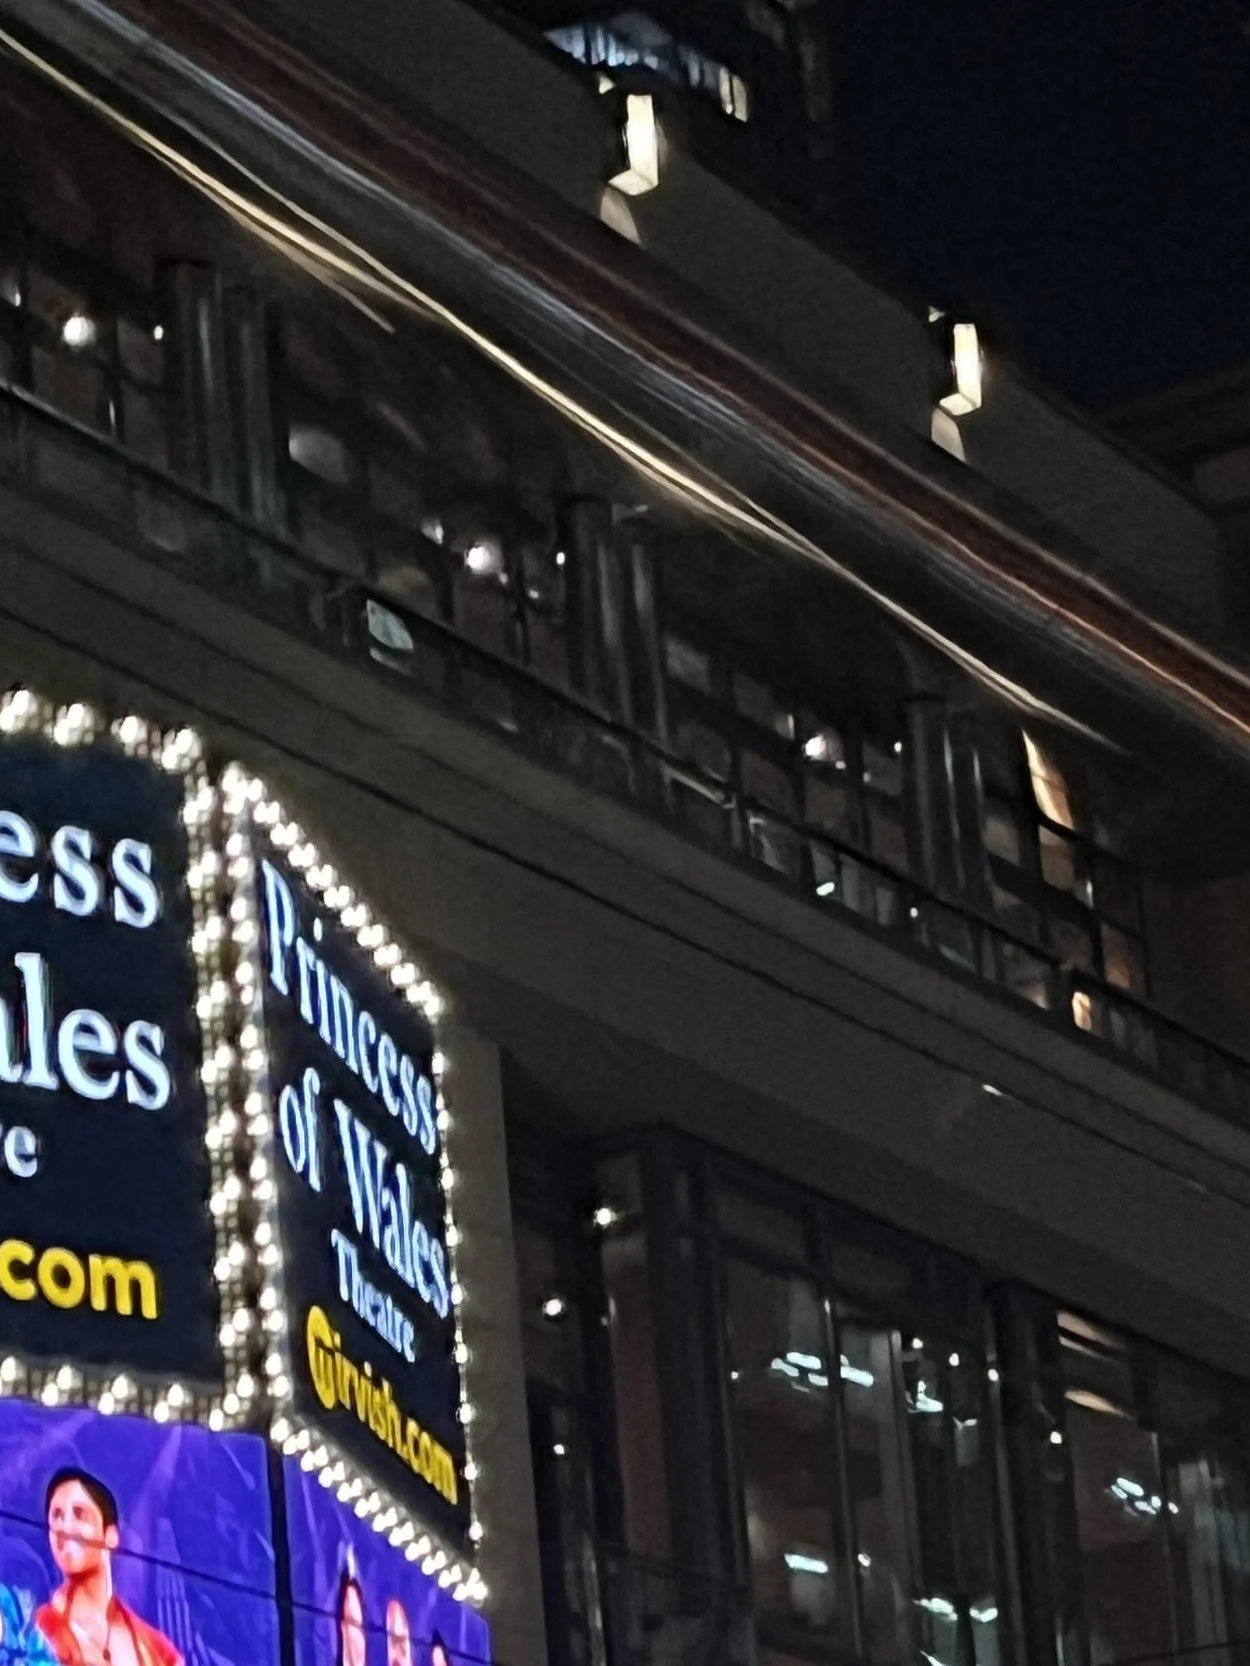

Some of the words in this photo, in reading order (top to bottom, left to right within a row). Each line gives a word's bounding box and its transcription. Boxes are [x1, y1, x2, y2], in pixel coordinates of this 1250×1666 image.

[261, 858, 436, 1156] Princess
[279, 1066, 322, 1193] of
[333, 1097, 449, 1319] Wales
